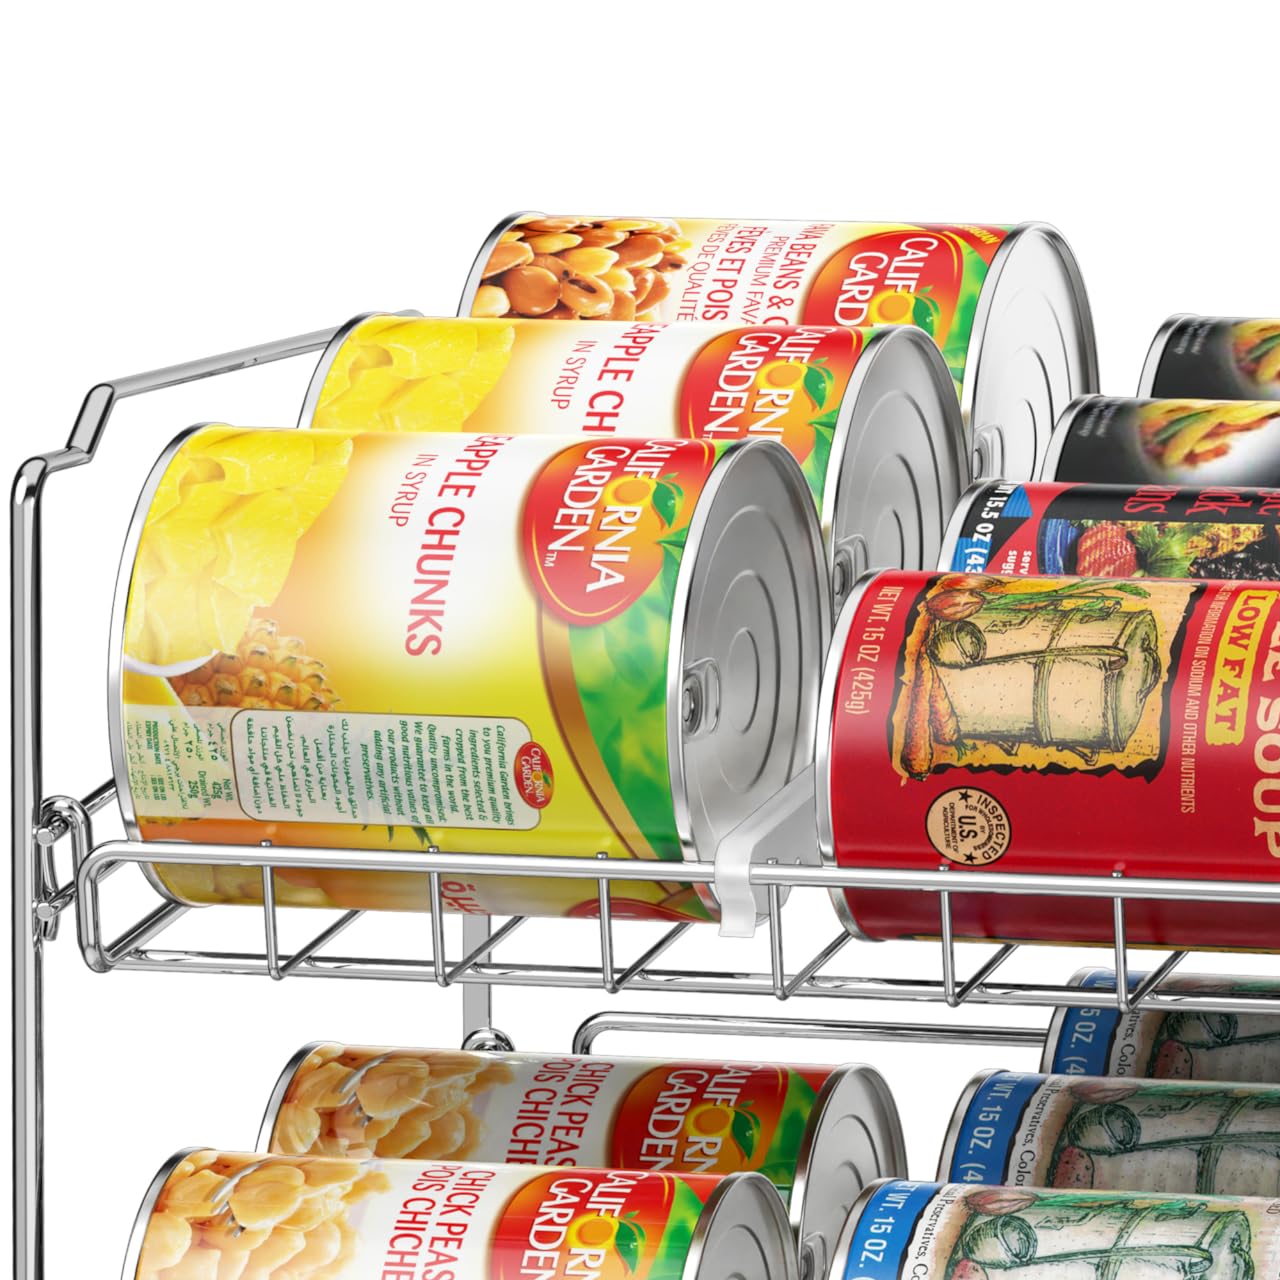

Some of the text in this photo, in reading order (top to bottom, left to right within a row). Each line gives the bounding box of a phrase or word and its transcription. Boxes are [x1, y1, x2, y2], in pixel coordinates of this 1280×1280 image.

[721, 255, 746, 271] ET
[767, 243, 813, 310] BEANS &
[702, 279, 737, 321] POIS
[550, 340, 598, 410] IN SYRUP
[389, 454, 438, 527] IN SYRUP
[547, 445, 627, 552] GARDEN
[586, 439, 688, 592] CALIFORNIA
[973, 495, 1007, 543] 15.5 OZ
[1198, 601, 1227, 645] INFORMATION
[845, 586, 904, 715] NET WT. 15 OZ (425g)
[1194, 646, 1210, 658] ON
[1214, 591, 1280, 731] LOW FAT
[1187, 660, 1207, 697] SODIUM
[1184, 698, 1201, 719] AND
[373, 730, 384, 760] adding
[481, 739, 492, 755] you
[483, 727, 492, 736] to
[496, 725, 507, 770] California
[1181, 723, 1198, 755] OTHER
[376, 762, 386, 777] any
[387, 747, 399, 783] products
[454, 728, 474, 820] cropped from the best
[484, 757, 497, 794] premium
[499, 771, 511, 800] Garden
[1180, 758, 1196, 814] NUTRIENTS
[942, 807, 951, 849] AGRICULTURE
[949, 802, 958, 845] DEPARTMENT
[958, 816, 978, 842] U.S.
[976, 795, 1006, 860] INSPECTED
[561, 1062, 615, 1105] CHICK
[440, 1169, 496, 1216] CHICK
[870, 1214, 896, 1234] 15
[915, 1199, 952, 1260] Preservatives,
[858, 1240, 887, 1268] OZ.
